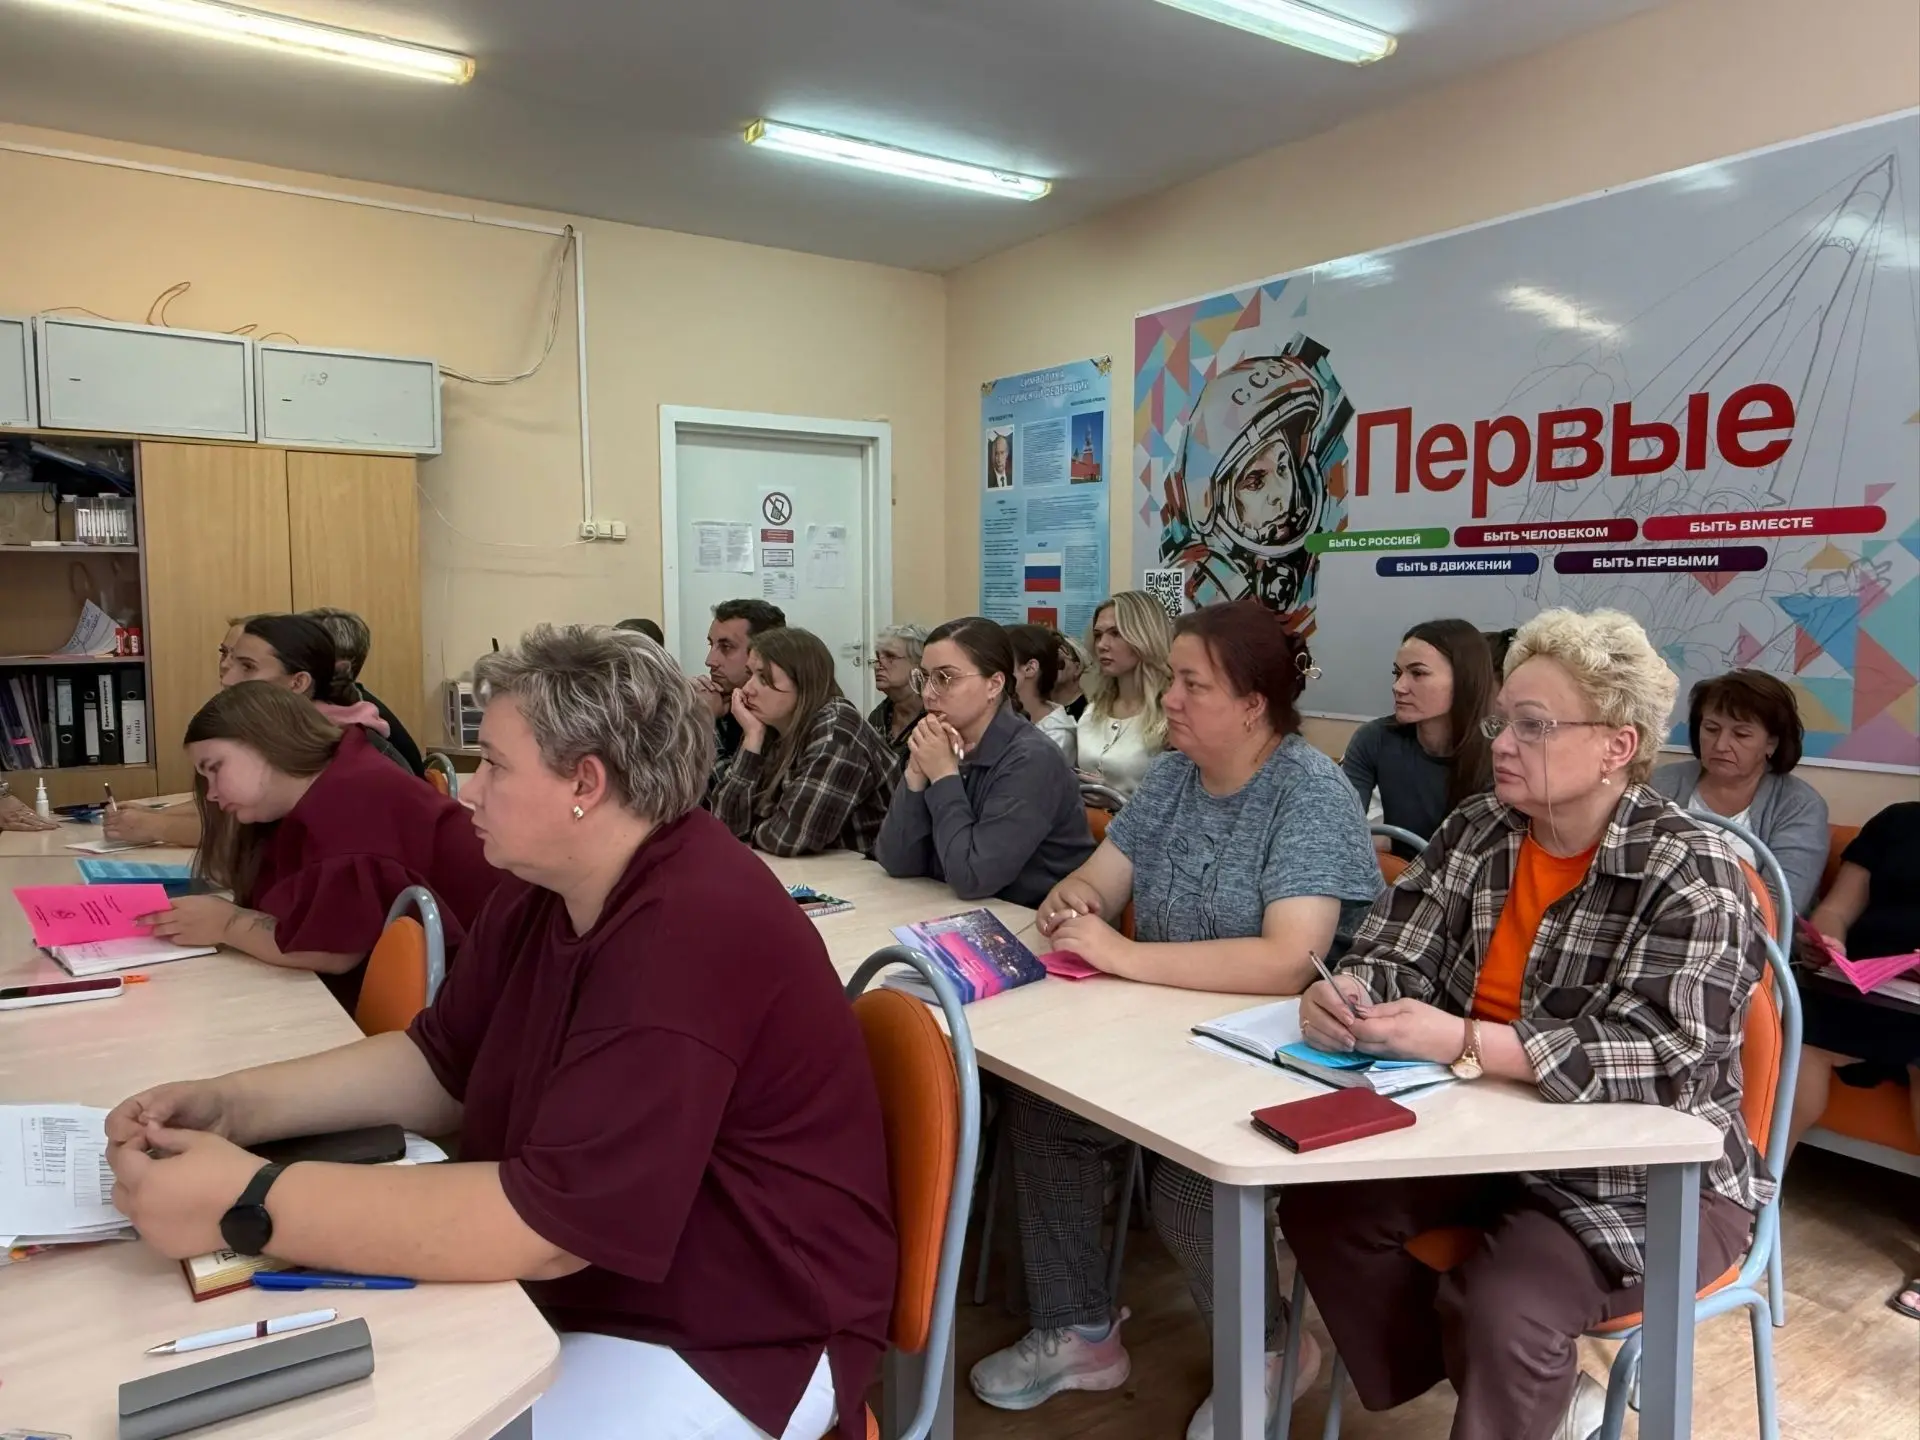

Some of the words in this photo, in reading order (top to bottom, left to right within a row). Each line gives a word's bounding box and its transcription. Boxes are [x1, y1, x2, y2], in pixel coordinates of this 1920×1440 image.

[1355, 383, 1796, 519] Первые
[1689, 520, 1736, 533] БЫТЬ
[1739, 517, 1814, 531] ВМЕСТЕ
[1328, 539, 1357, 549] БЫТЬ
[1358, 538, 1367, 547] С
[1368, 533, 1421, 547] РОССИЕЙ
[1483, 529, 1519, 542] БЫТЬ
[1521, 525, 1609, 541] ЧЕЛОВЕКОМ
[1396, 562, 1428, 572] БЫТЬ
[1429, 562, 1438, 572] В
[1439, 560, 1512, 573] ДВИЖЕНИИ
[1592, 557, 1634, 569] БЫТЬ
[1636, 555, 1719, 567] ПЕРВЫМИ
